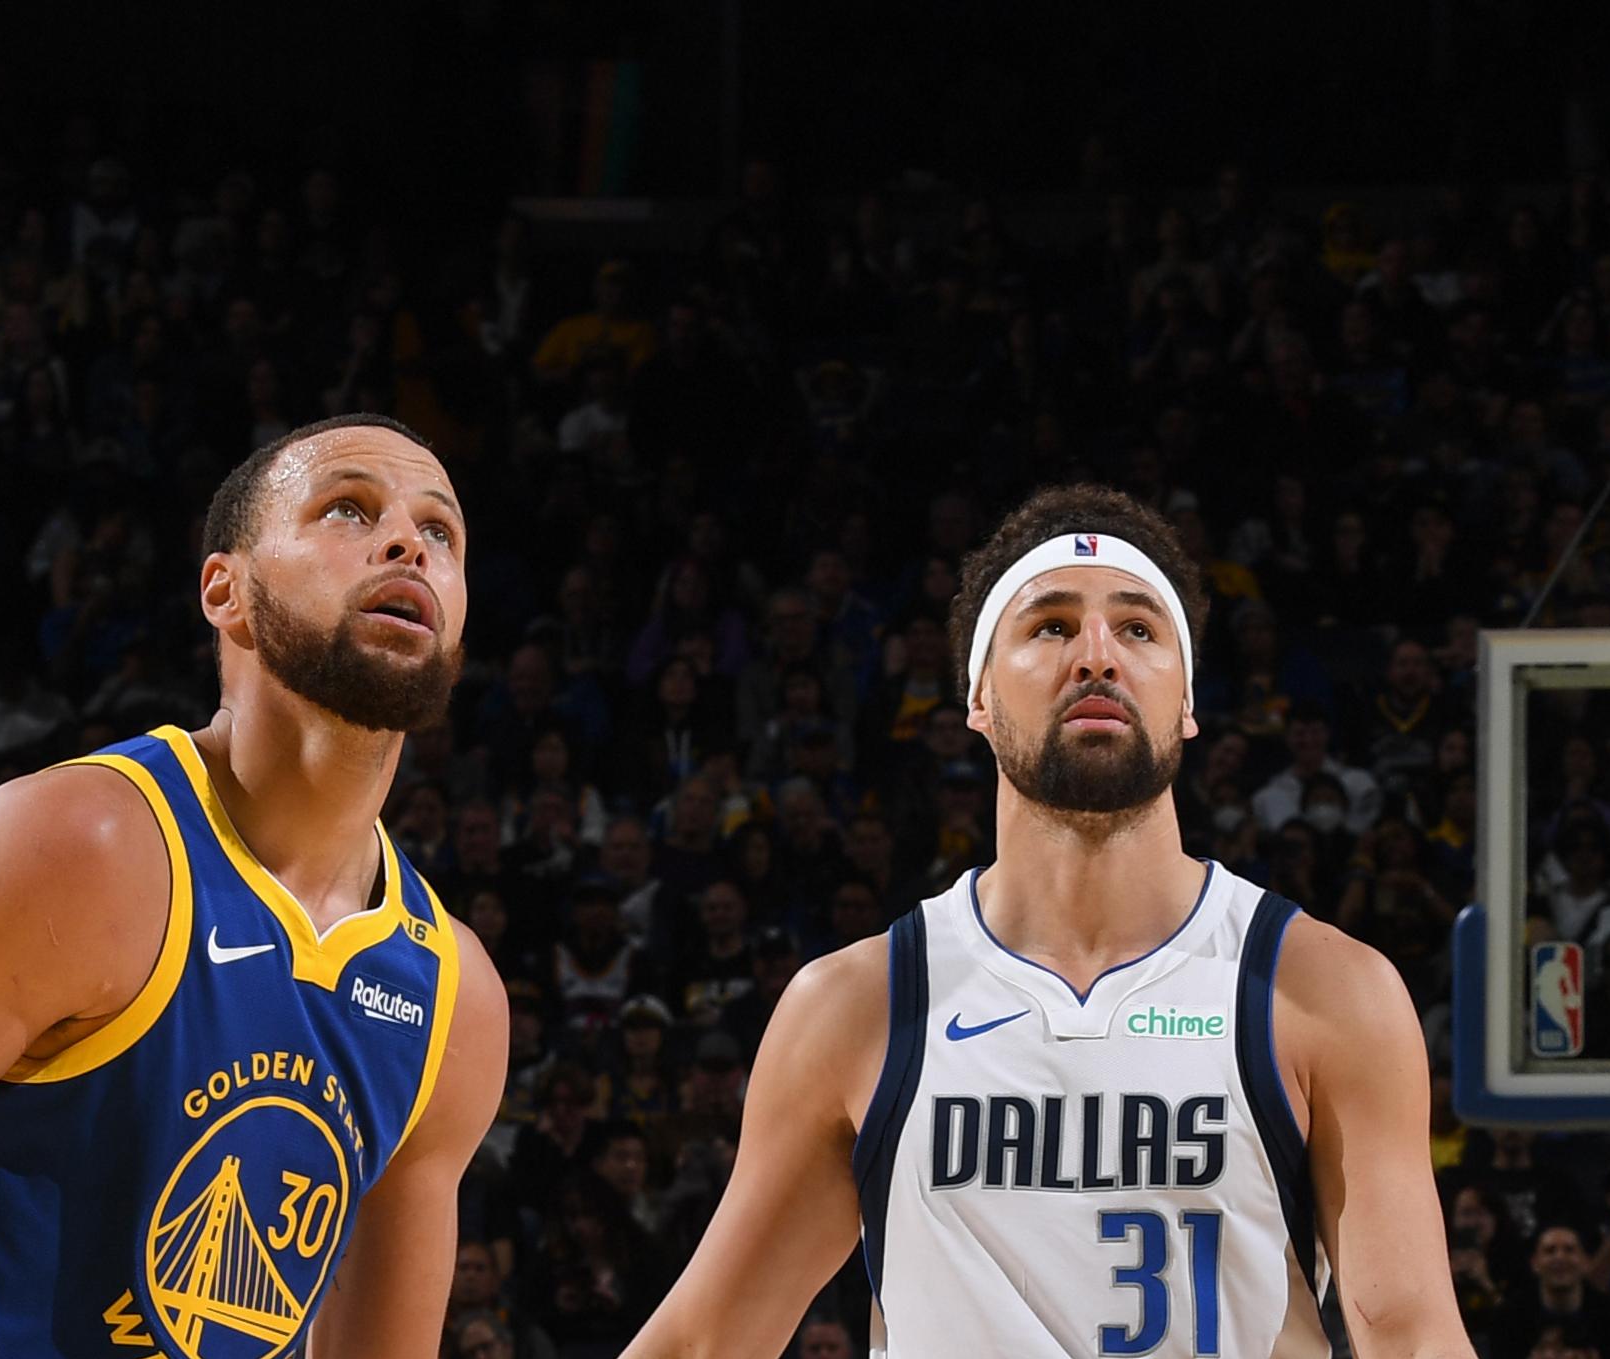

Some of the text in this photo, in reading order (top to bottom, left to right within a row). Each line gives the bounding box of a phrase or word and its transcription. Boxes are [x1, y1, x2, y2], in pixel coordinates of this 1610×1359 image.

[351, 977, 424, 1027] Rakuten
[1128, 1005, 1224, 1037] chime
[184, 1051, 315, 1119] GOLDEN
[930, 1093, 1228, 1192] DALLAS
[267, 1170, 339, 1259] 30
[1097, 1209, 1223, 1359] 31
